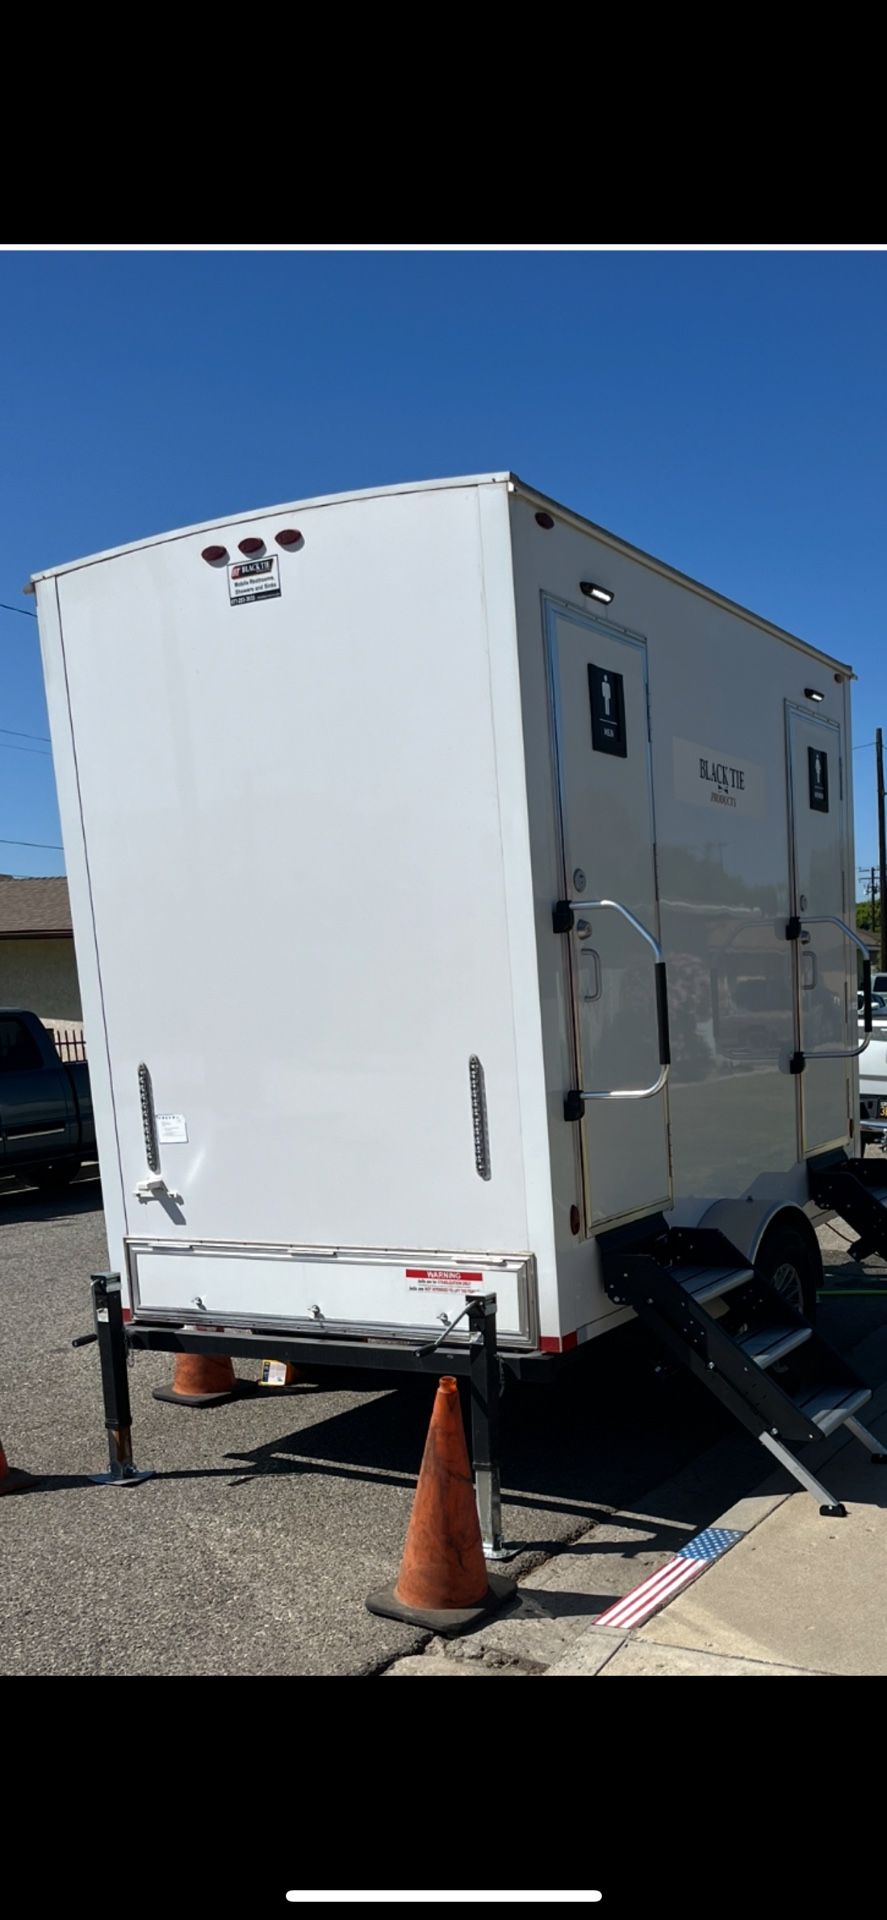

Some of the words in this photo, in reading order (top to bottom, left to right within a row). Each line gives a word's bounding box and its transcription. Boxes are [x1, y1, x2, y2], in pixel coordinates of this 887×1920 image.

[242, 563, 260, 574] BLACK
[236, 587, 254, 595] Showers
[699, 758, 729, 786] BLACK
[729, 767, 745, 790] TIE
[711, 792, 737, 808] PRODUCTS
[427, 1271, 461, 1280] WARNING
